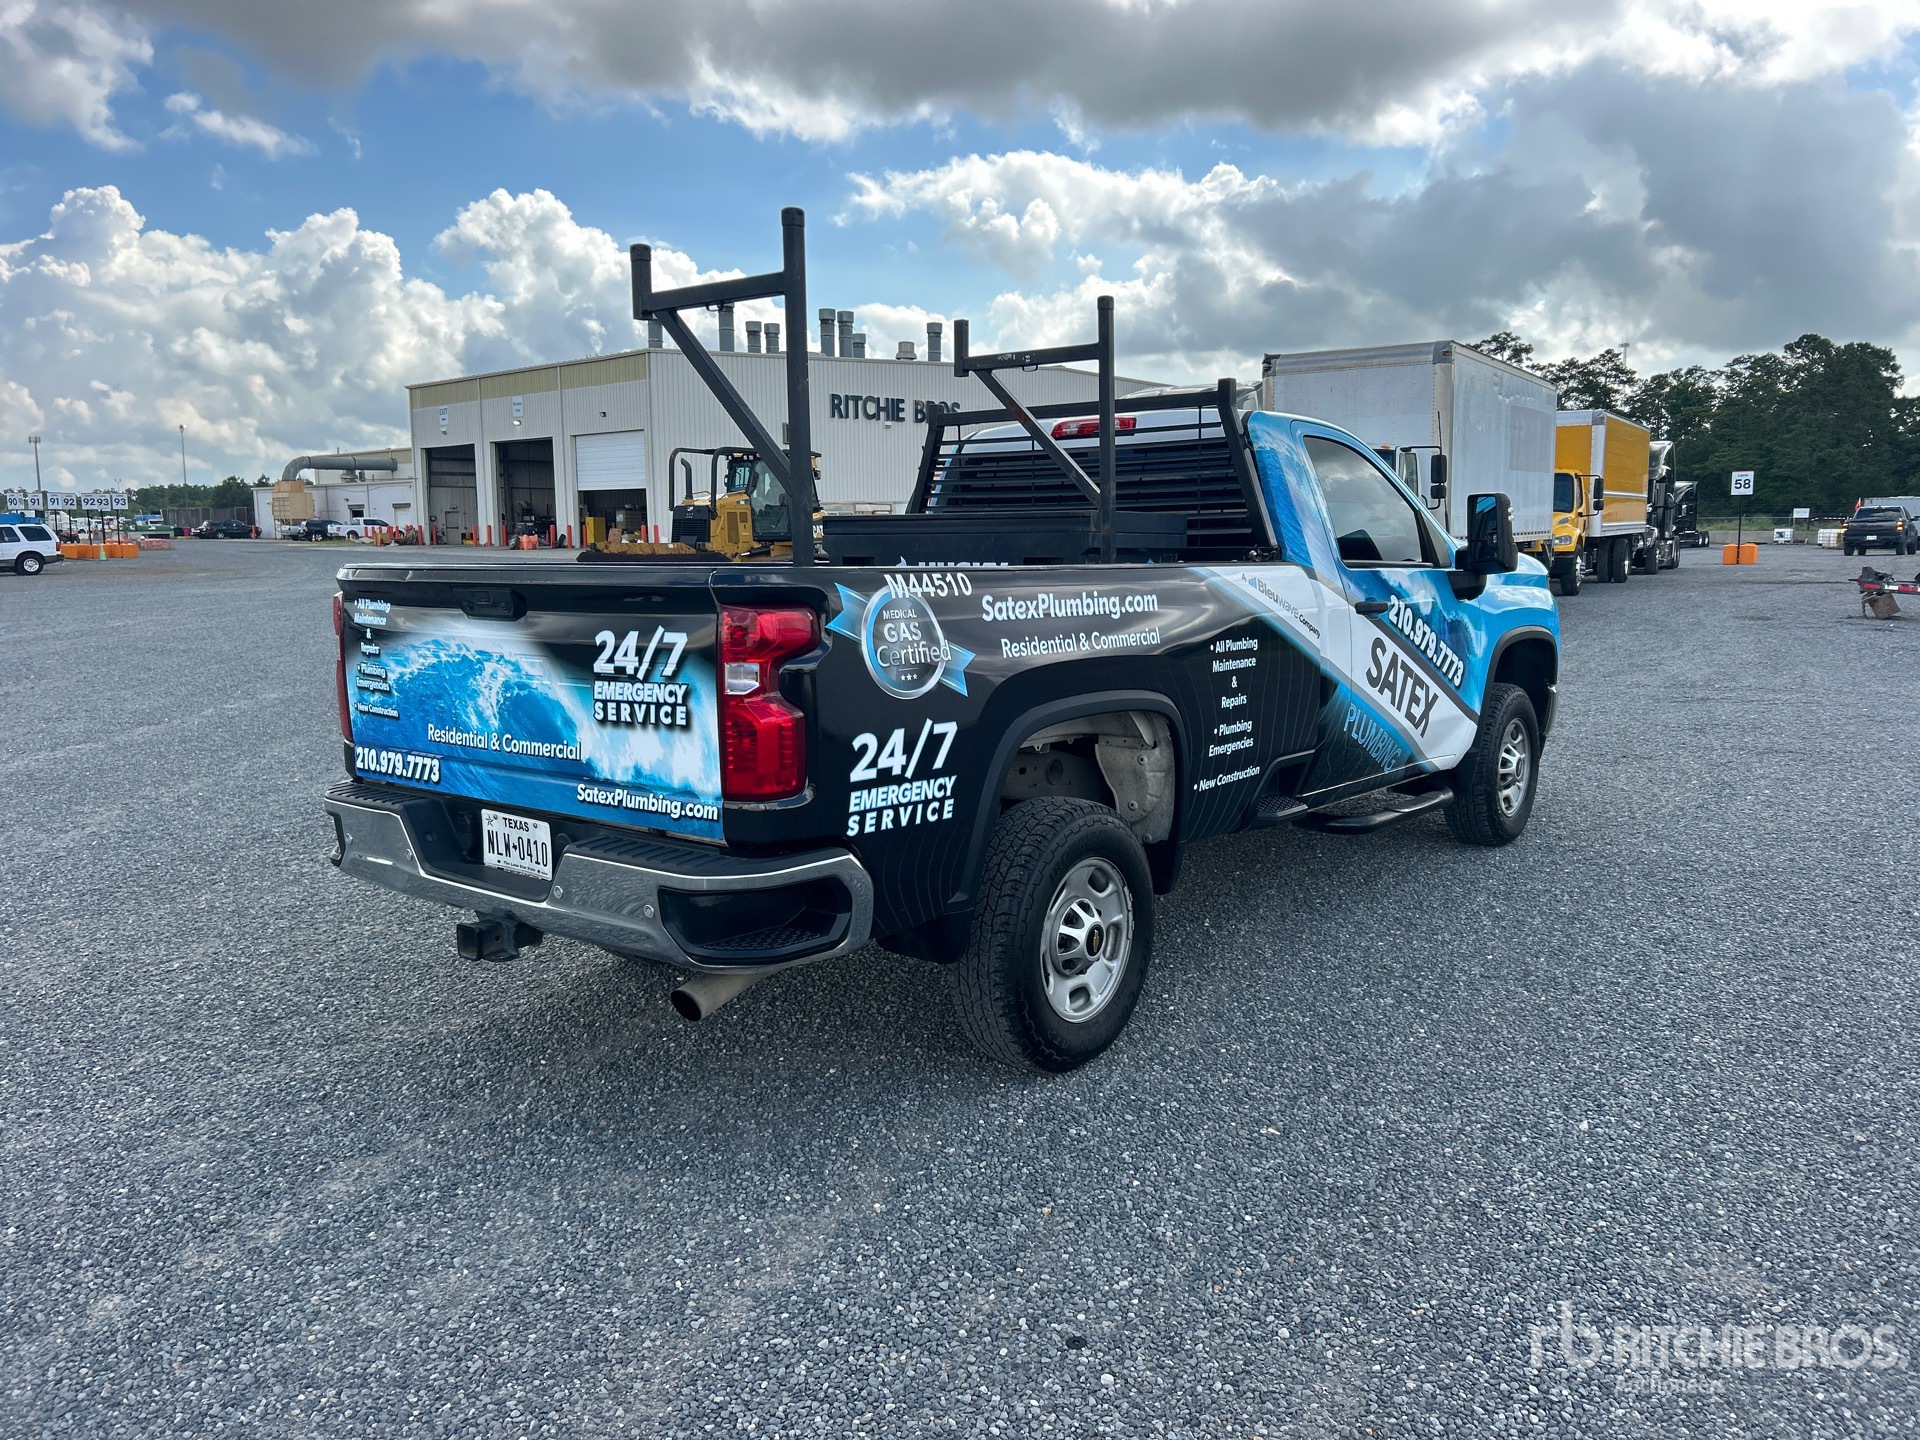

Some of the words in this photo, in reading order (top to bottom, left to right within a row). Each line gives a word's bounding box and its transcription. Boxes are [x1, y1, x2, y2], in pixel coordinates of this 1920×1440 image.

[829, 393, 905, 422] RITCHIE
[913, 399, 961, 423] BS
[1734, 478, 1751, 489] 58
[8, 497, 18, 506] 90
[30, 497, 40, 506] 91
[49, 497, 60, 506] 91
[63, 498, 75, 506] 92
[83, 498, 96, 506] 92
[96, 498, 110, 506] 93
[114, 498, 127, 506] 93
[883, 572, 973, 599] M44510
[357, 598, 365, 609] All
[365, 598, 391, 614] Plumbing
[882, 608, 918, 620] MEDICAL
[980, 591, 1159, 622] SatexPlumbing.com
[353, 612, 387, 626] Maintenance
[1298, 614, 1321, 639] Company
[366, 628, 372, 639] &
[883, 621, 923, 643] GAS
[1387, 594, 1465, 687] 210.979.7773
[360, 642, 380, 656] Repairs
[1000, 633, 1078, 659] Residential
[1079, 633, 1091, 651] &
[1091, 627, 1161, 650] Commercial
[1215, 640, 1226, 654] All
[1225, 636, 1259, 653] Plumbing
[593, 625, 689, 681] 24/7
[876, 639, 952, 669] Certified
[360, 662, 387, 679] Plumbing
[1212, 656, 1256, 673] Maintenance
[356, 677, 390, 691] Emergencies
[1231, 676, 1238, 688] &
[1365, 636, 1439, 739] SATEX
[593, 680, 688, 704] EMERGENCY
[357, 702, 369, 712] New
[368, 704, 399, 718] Construction
[1221, 694, 1247, 710] Repairs
[593, 702, 687, 726] SERVICE
[1219, 719, 1253, 736] Plumbing
[427, 723, 488, 749] Residential
[490, 733, 501, 751] &
[502, 734, 582, 761] Commercial
[1208, 736, 1254, 757] Emergencies
[1343, 703, 1403, 772] PLUMBING
[850, 717, 958, 783] 24/7
[355, 746, 441, 783] 210.979.7773
[1198, 776, 1216, 792] New
[1216, 765, 1261, 786] Construction
[576, 783, 719, 820] SatexPlumbing.com
[849, 775, 958, 813] EMERGENCY
[502, 817, 530, 832] TEXAS
[846, 798, 955, 837] SERVICE
